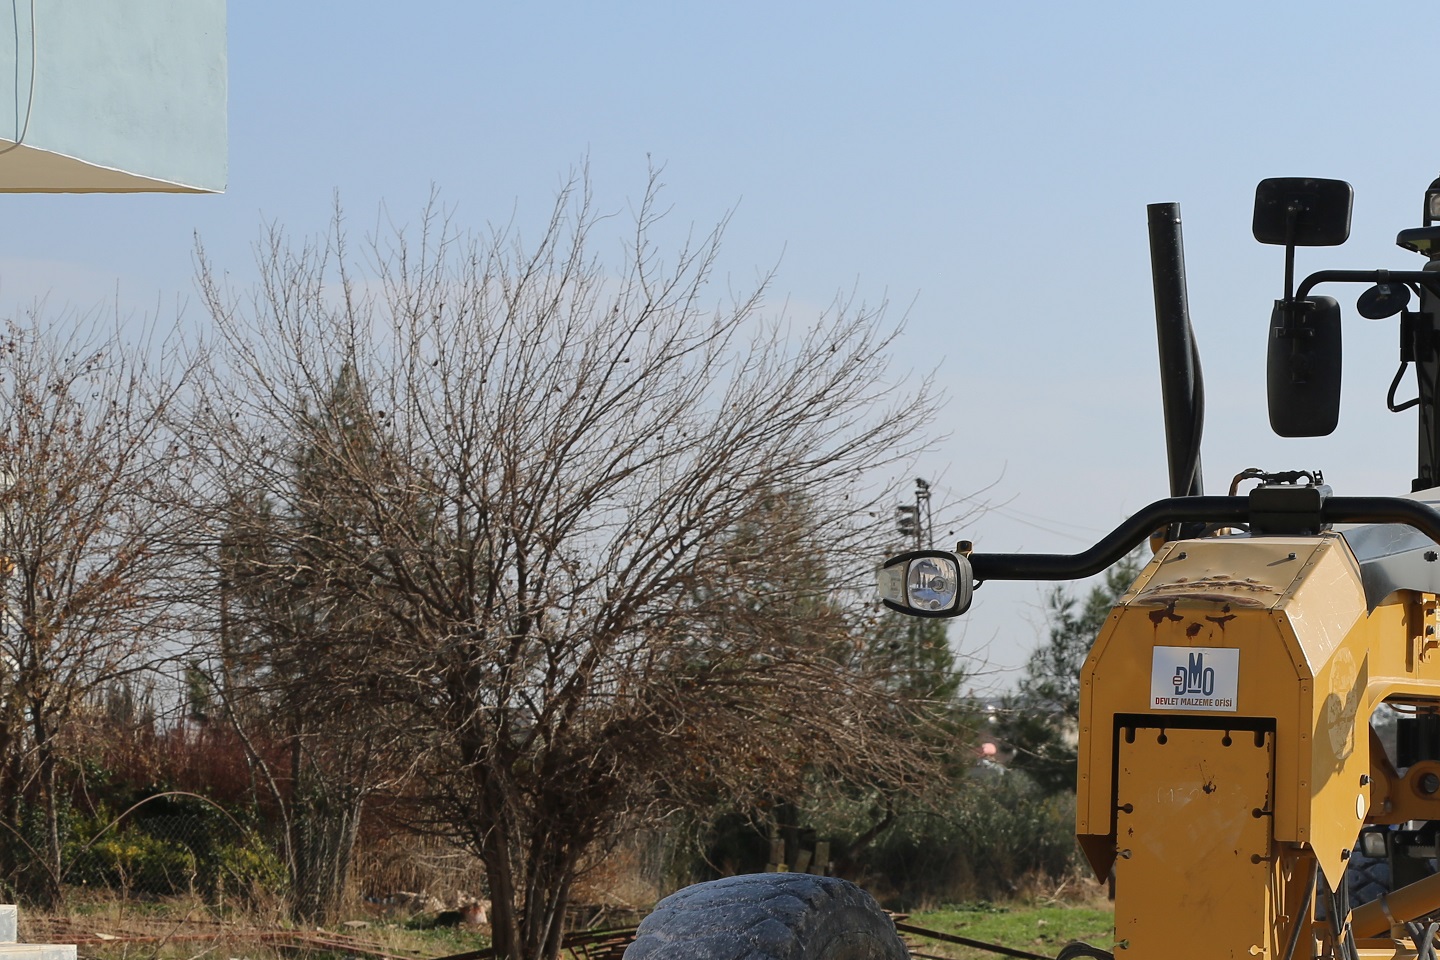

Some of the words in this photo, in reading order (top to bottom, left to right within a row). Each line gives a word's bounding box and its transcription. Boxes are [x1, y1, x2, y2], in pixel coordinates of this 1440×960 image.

[1155, 697, 1180, 706] DEVLET
[1180, 698, 1213, 707] MALZEME
[1214, 698, 1232, 707] OFİSİ
